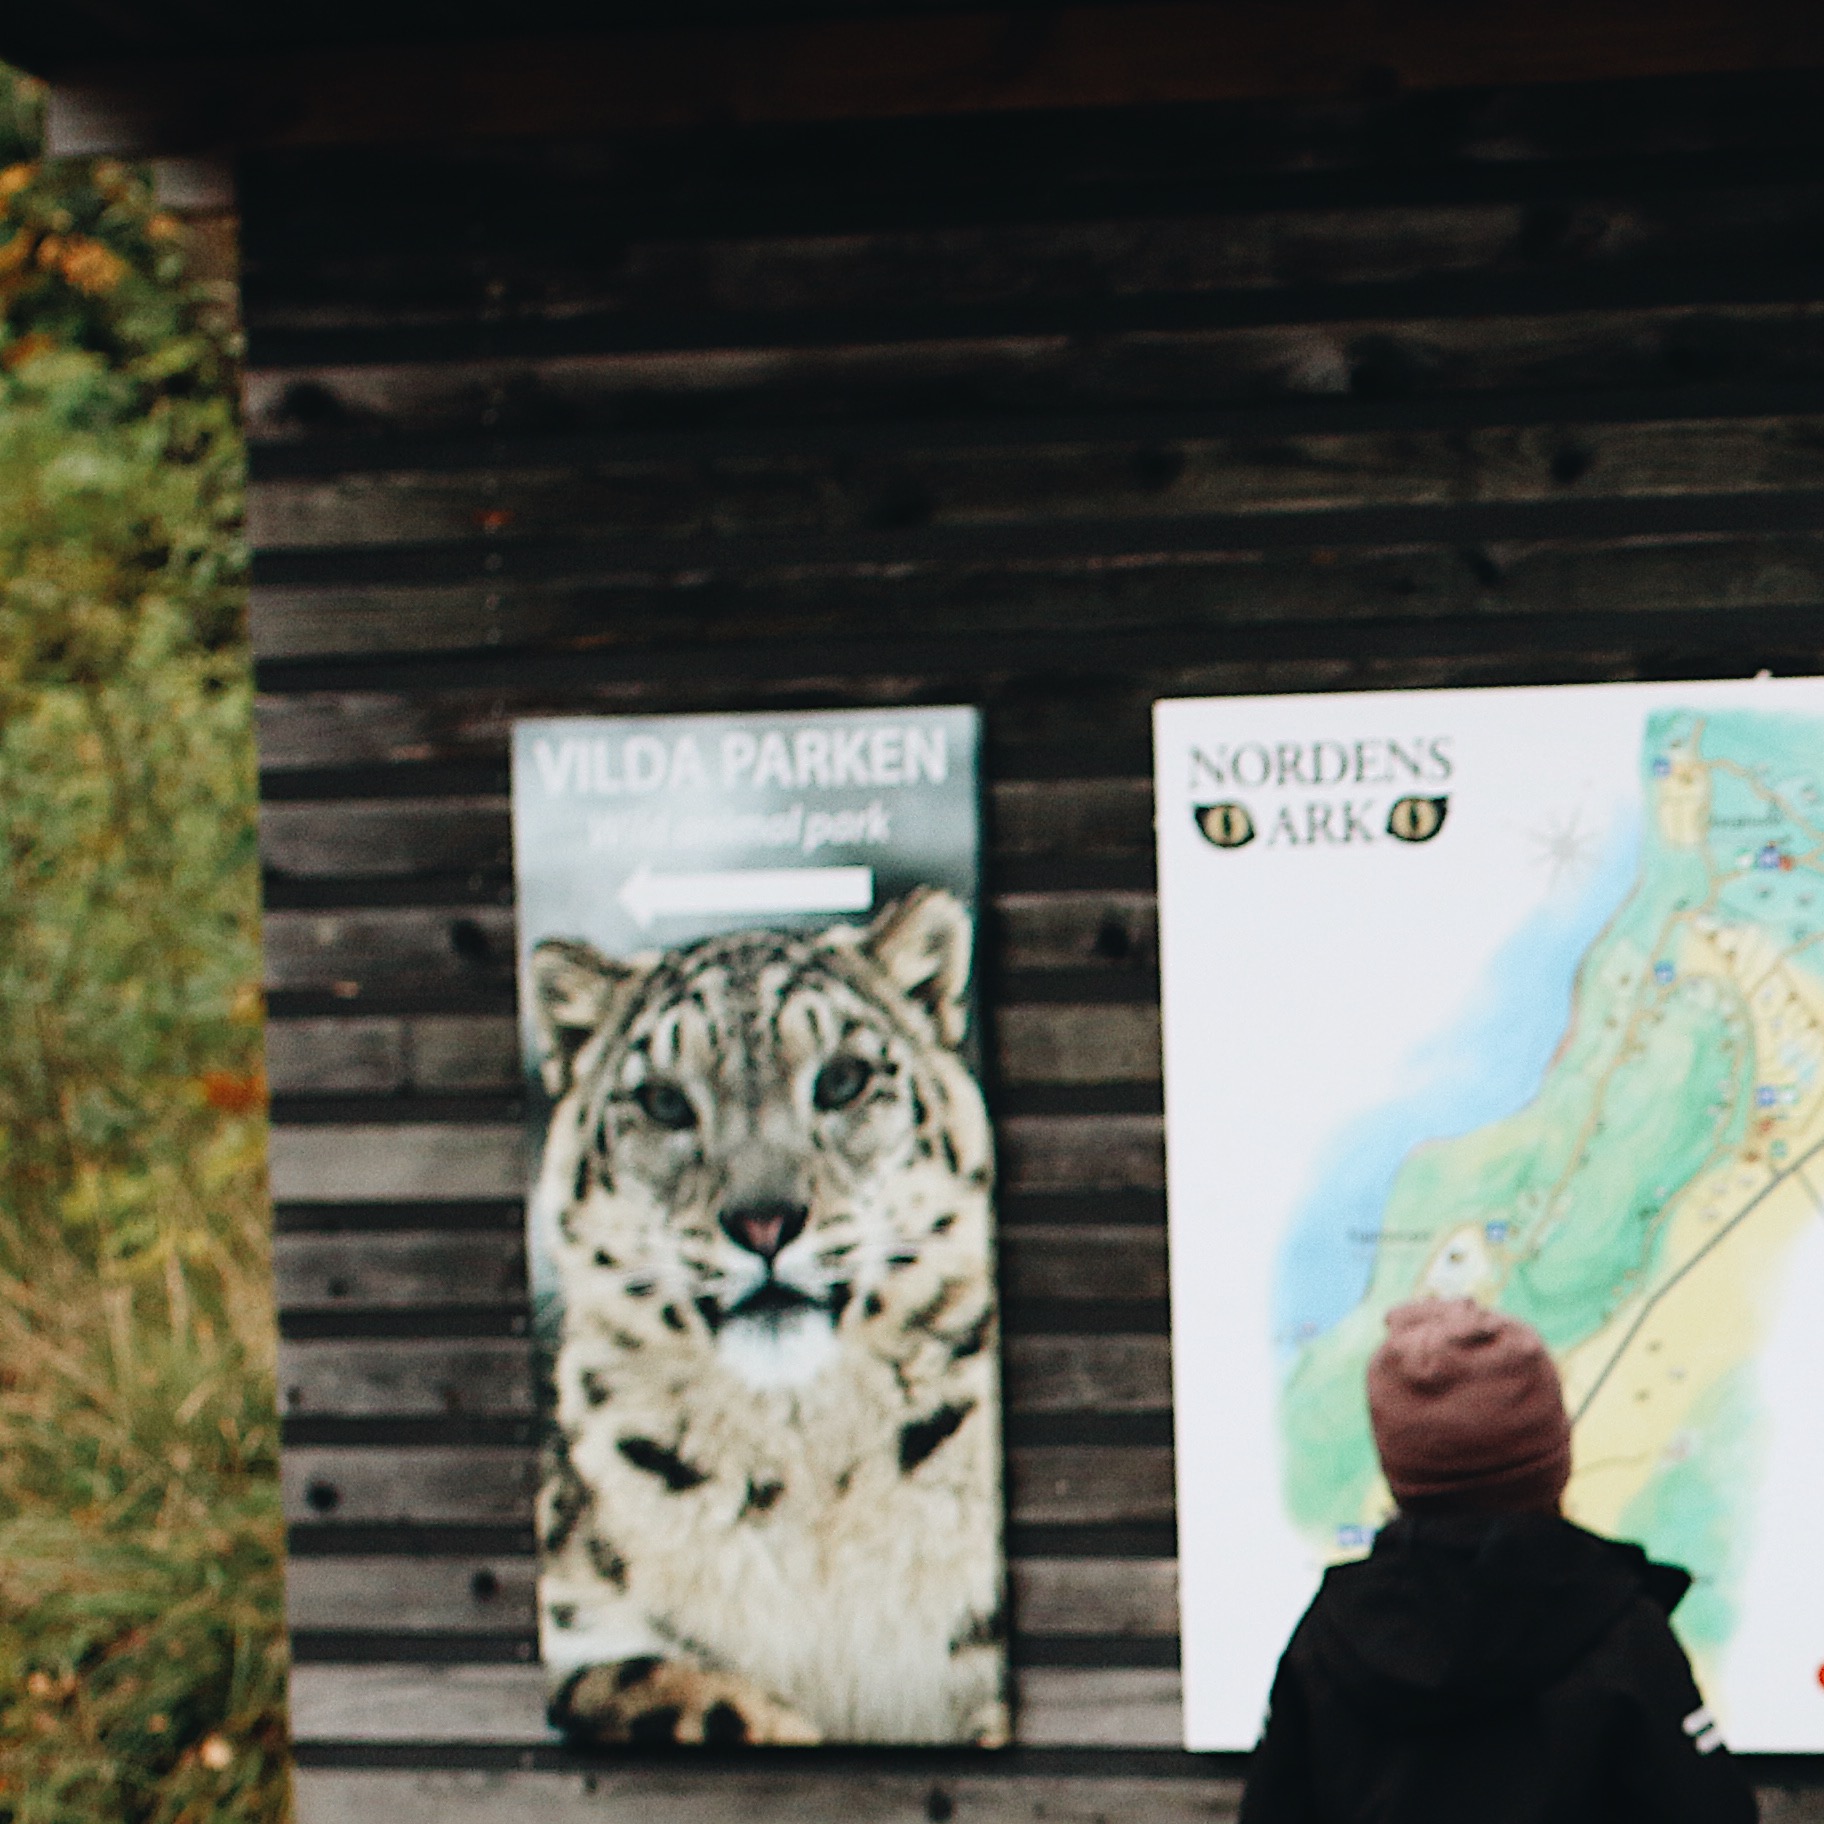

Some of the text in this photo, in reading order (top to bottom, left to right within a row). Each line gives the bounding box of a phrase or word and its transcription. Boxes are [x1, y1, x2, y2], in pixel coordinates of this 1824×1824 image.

[534, 726, 949, 795] VILDA PARKEN
[1188, 736, 1455, 788] NORDENS
[803, 802, 891, 855] park
[1267, 800, 1374, 846] ARK
